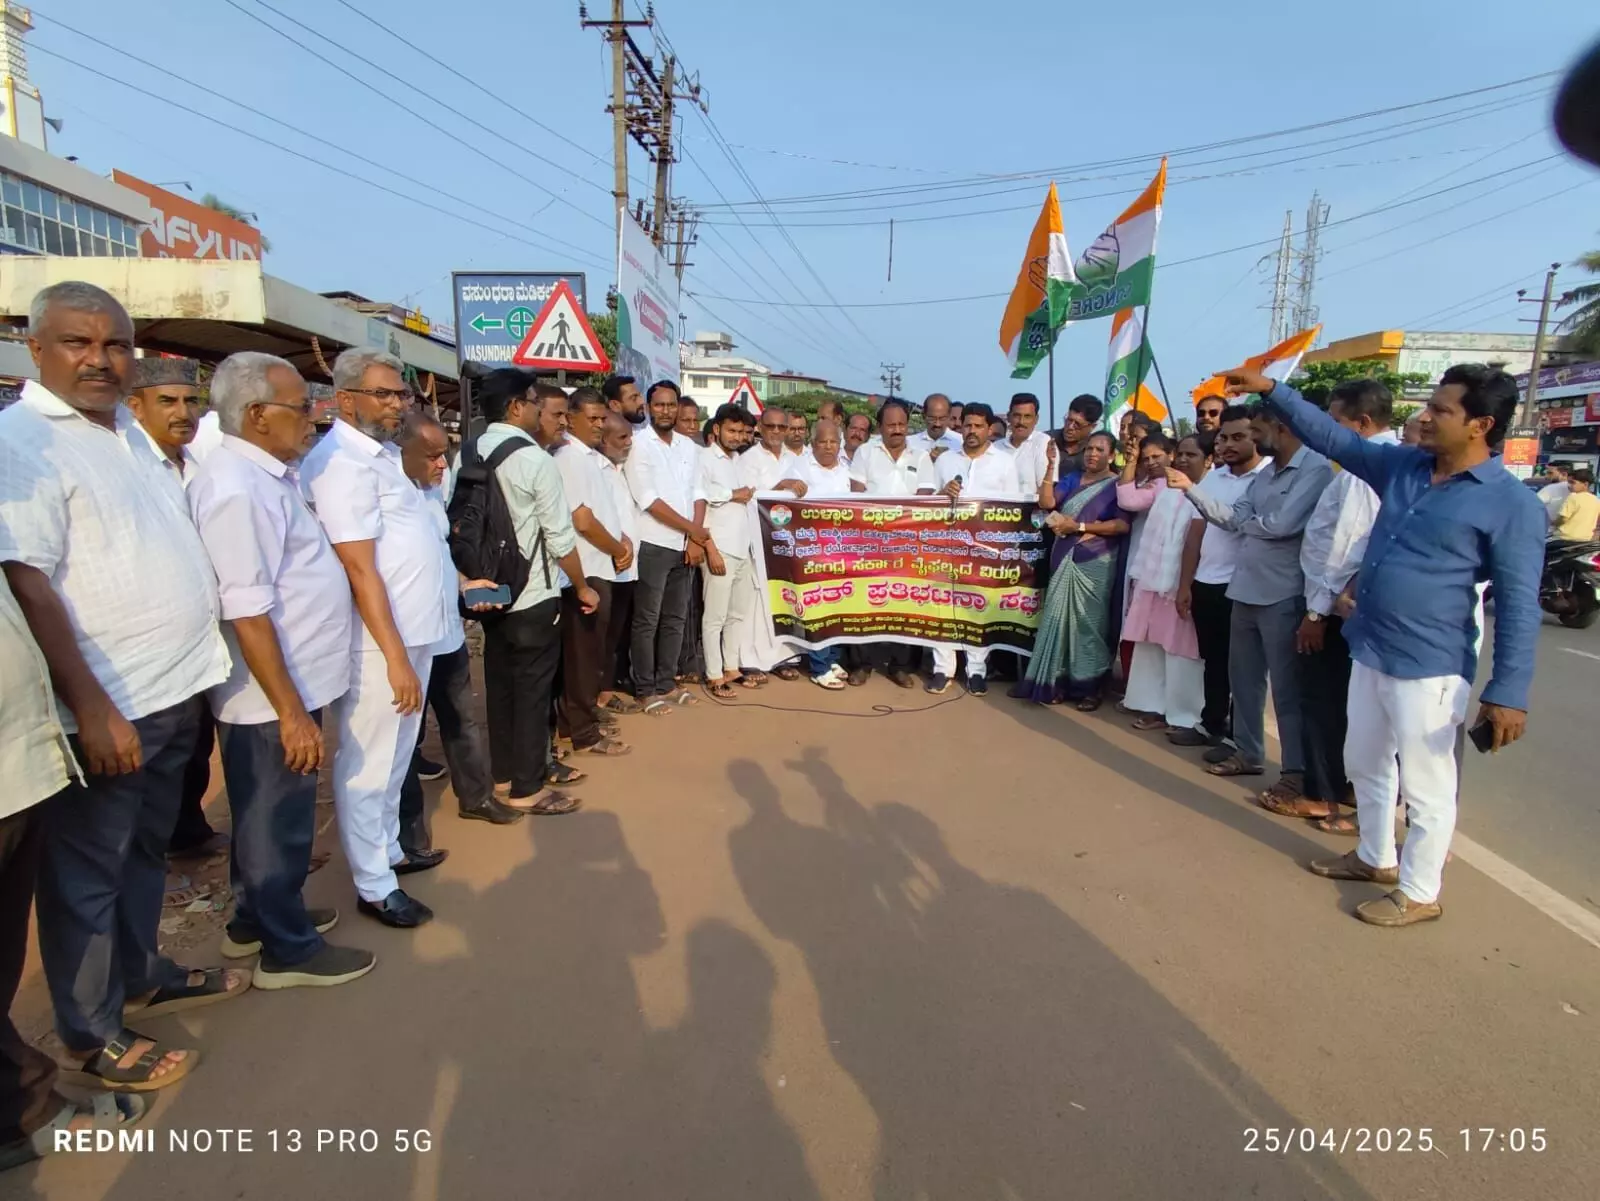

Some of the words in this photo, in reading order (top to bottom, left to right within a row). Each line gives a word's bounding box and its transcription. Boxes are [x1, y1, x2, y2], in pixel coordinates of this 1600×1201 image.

[464, 344, 520, 361] VASUNDHAR
[983, 506, 1022, 522] ಸಮಿತಿ
[867, 580, 987, 611] ಪ್ರತಿಭಟನಾ
